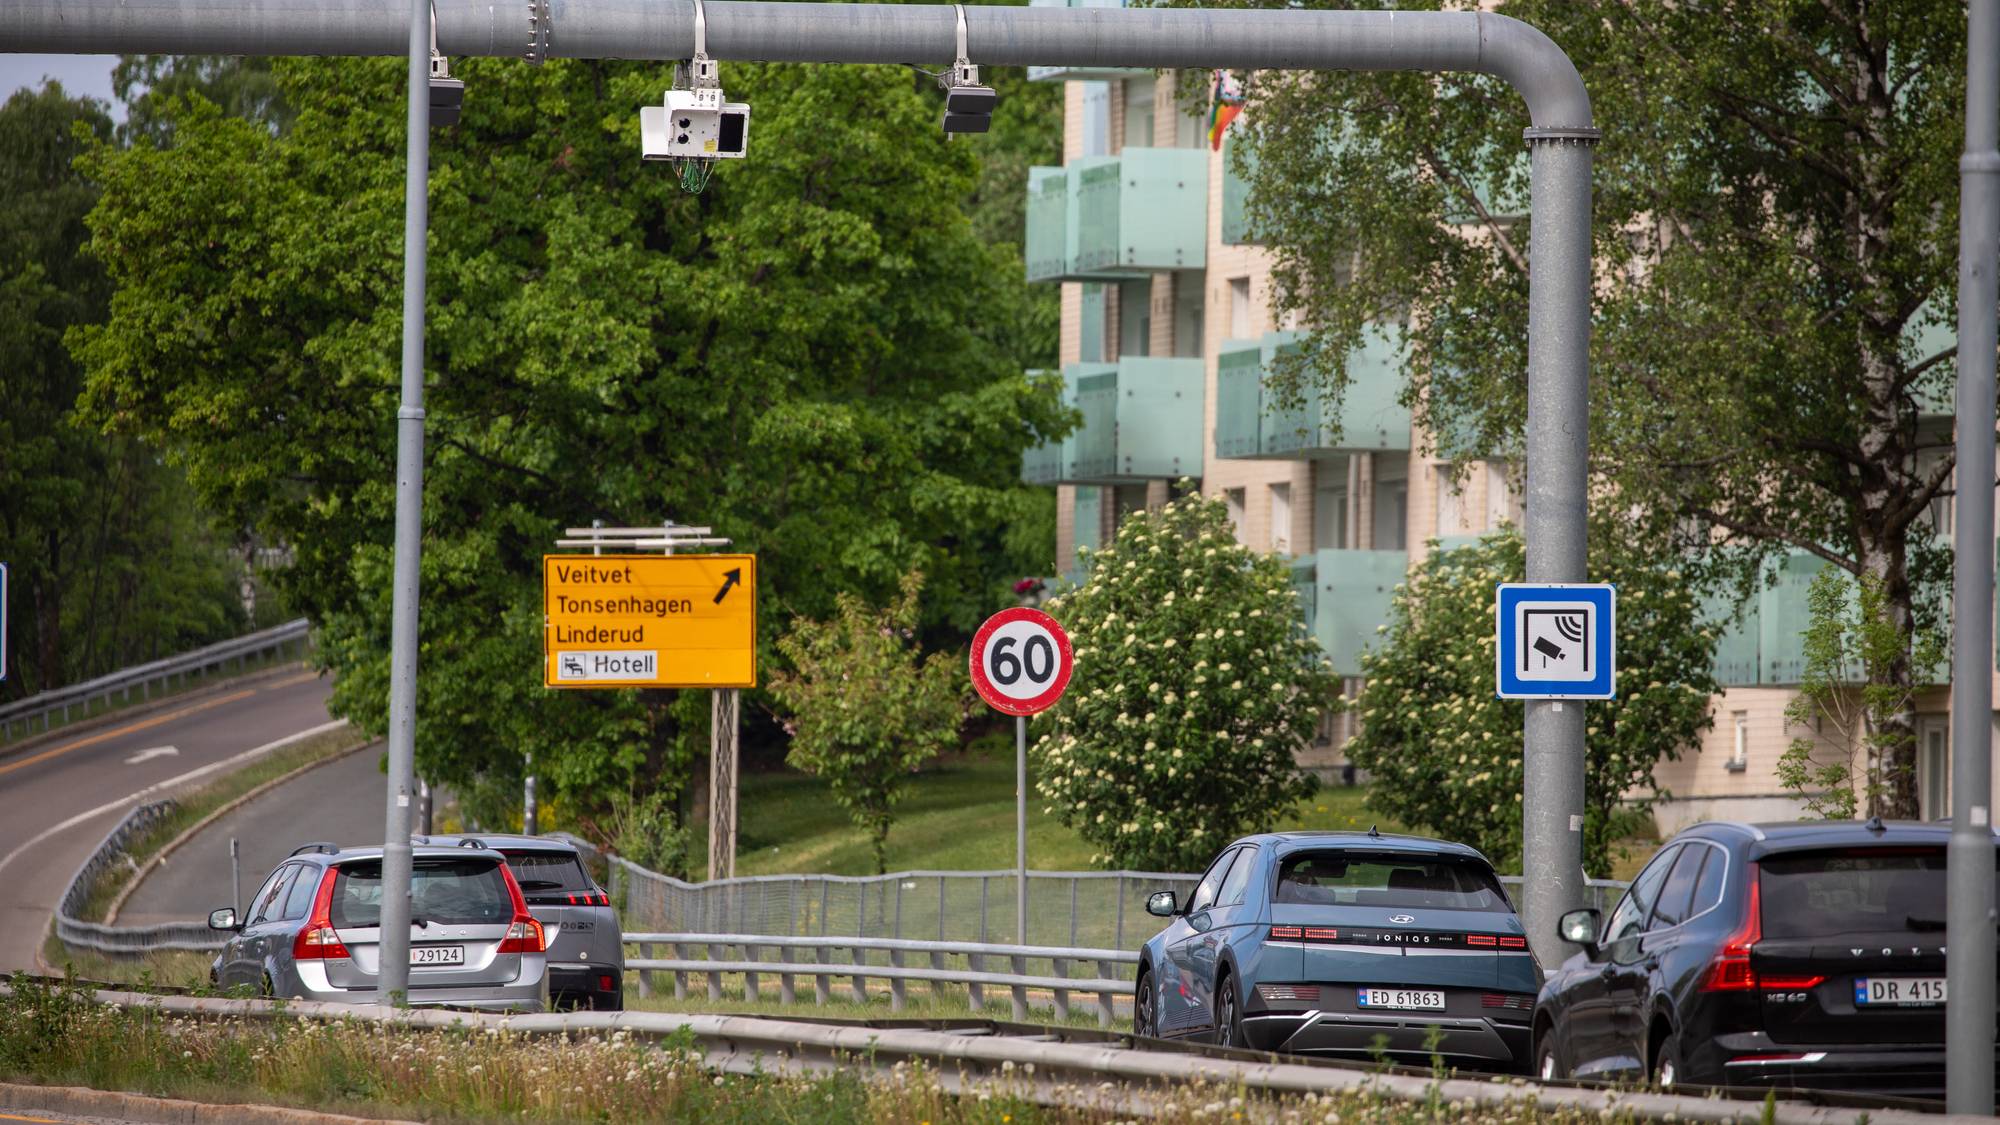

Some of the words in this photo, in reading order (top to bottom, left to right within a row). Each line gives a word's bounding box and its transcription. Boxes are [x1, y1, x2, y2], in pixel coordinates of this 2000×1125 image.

[557, 565, 632, 583] Veitvet
[557, 596, 692, 617] Tonsenhagen
[556, 625, 644, 644] Linderud
[594, 655, 653, 673] Hotell
[990, 634, 1054, 685] 60
[418, 948, 458, 962] 29124
[1850, 946, 1947, 956] VOLV
[1372, 991, 1389, 1004] ED
[1396, 991, 1440, 1006] 61863
[1873, 981, 1899, 1000] DR
[1909, 981, 1943, 1000] 415
